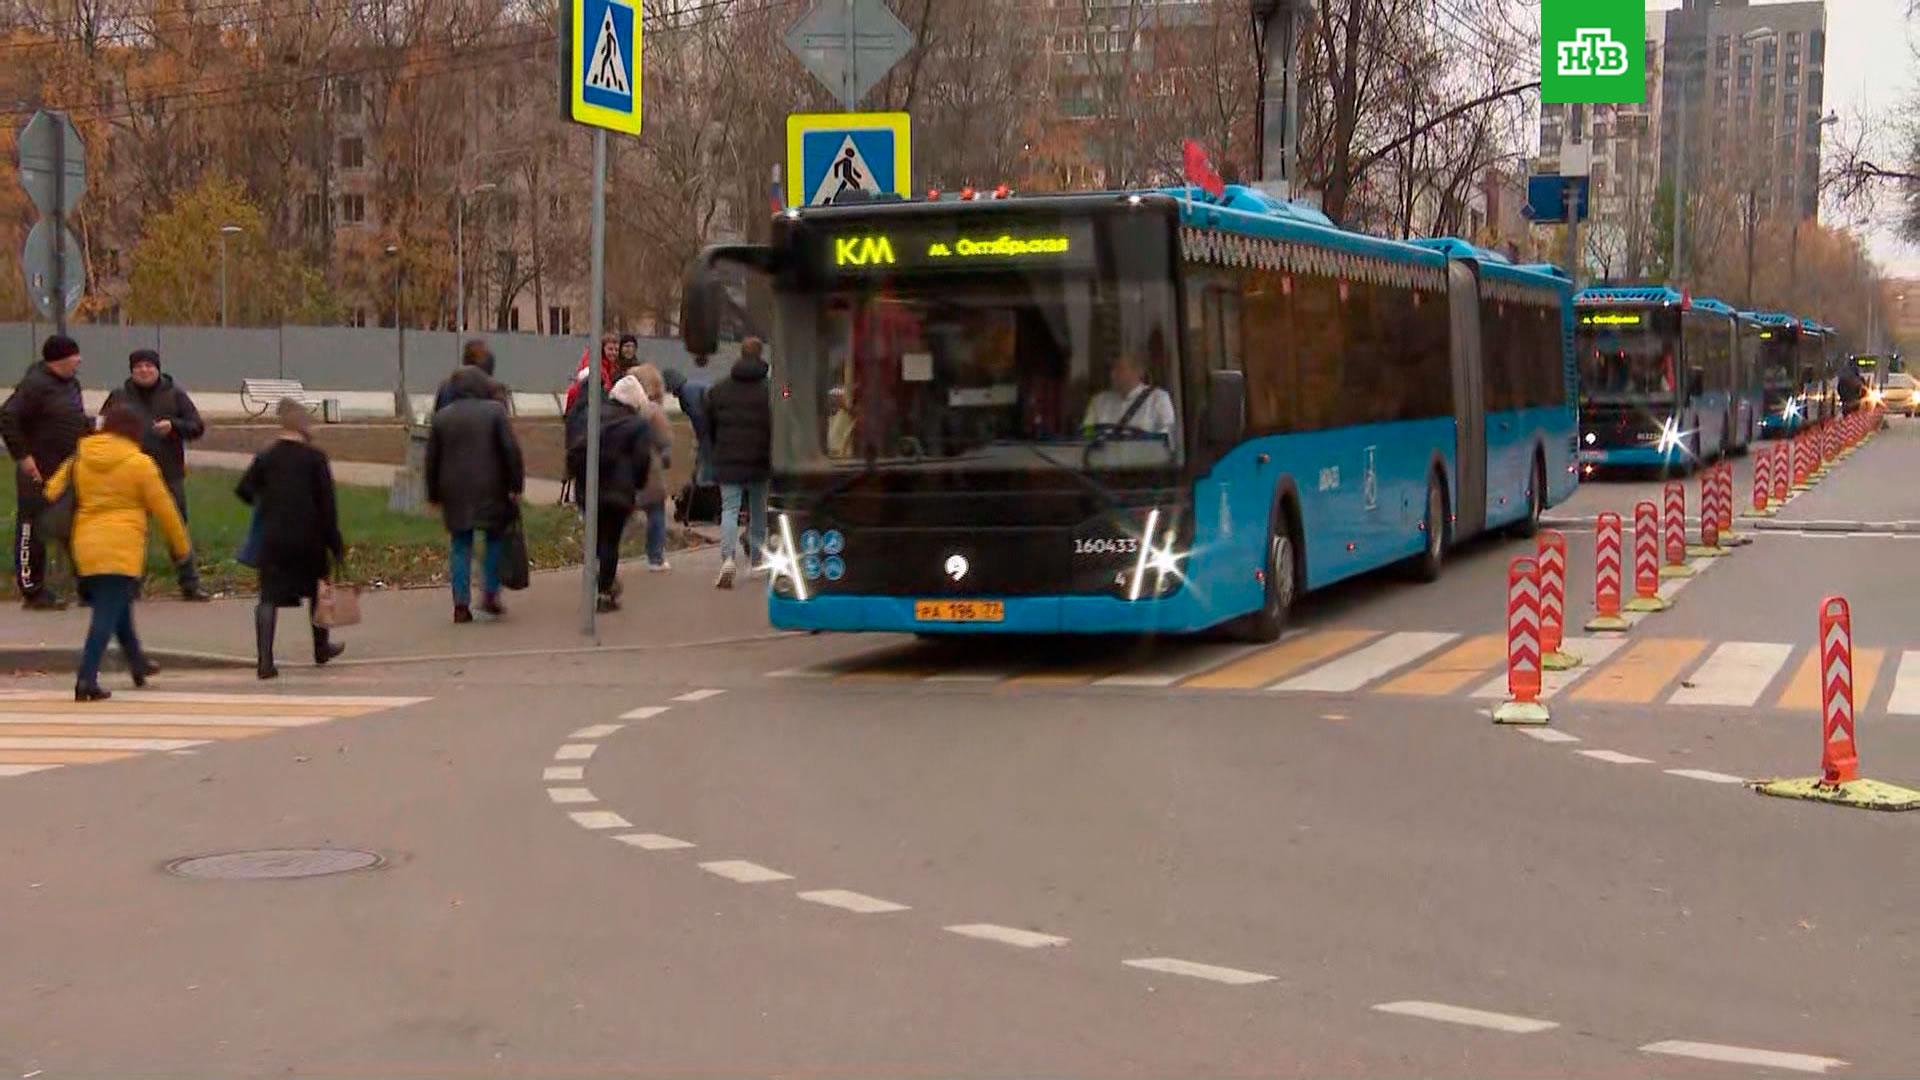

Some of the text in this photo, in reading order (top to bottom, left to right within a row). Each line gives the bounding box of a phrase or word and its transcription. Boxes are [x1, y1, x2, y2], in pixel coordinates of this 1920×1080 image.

[836, 237, 896, 266] КМ
[956, 235, 1068, 256] Октябрьская
[1074, 538, 1137, 553] 160433
